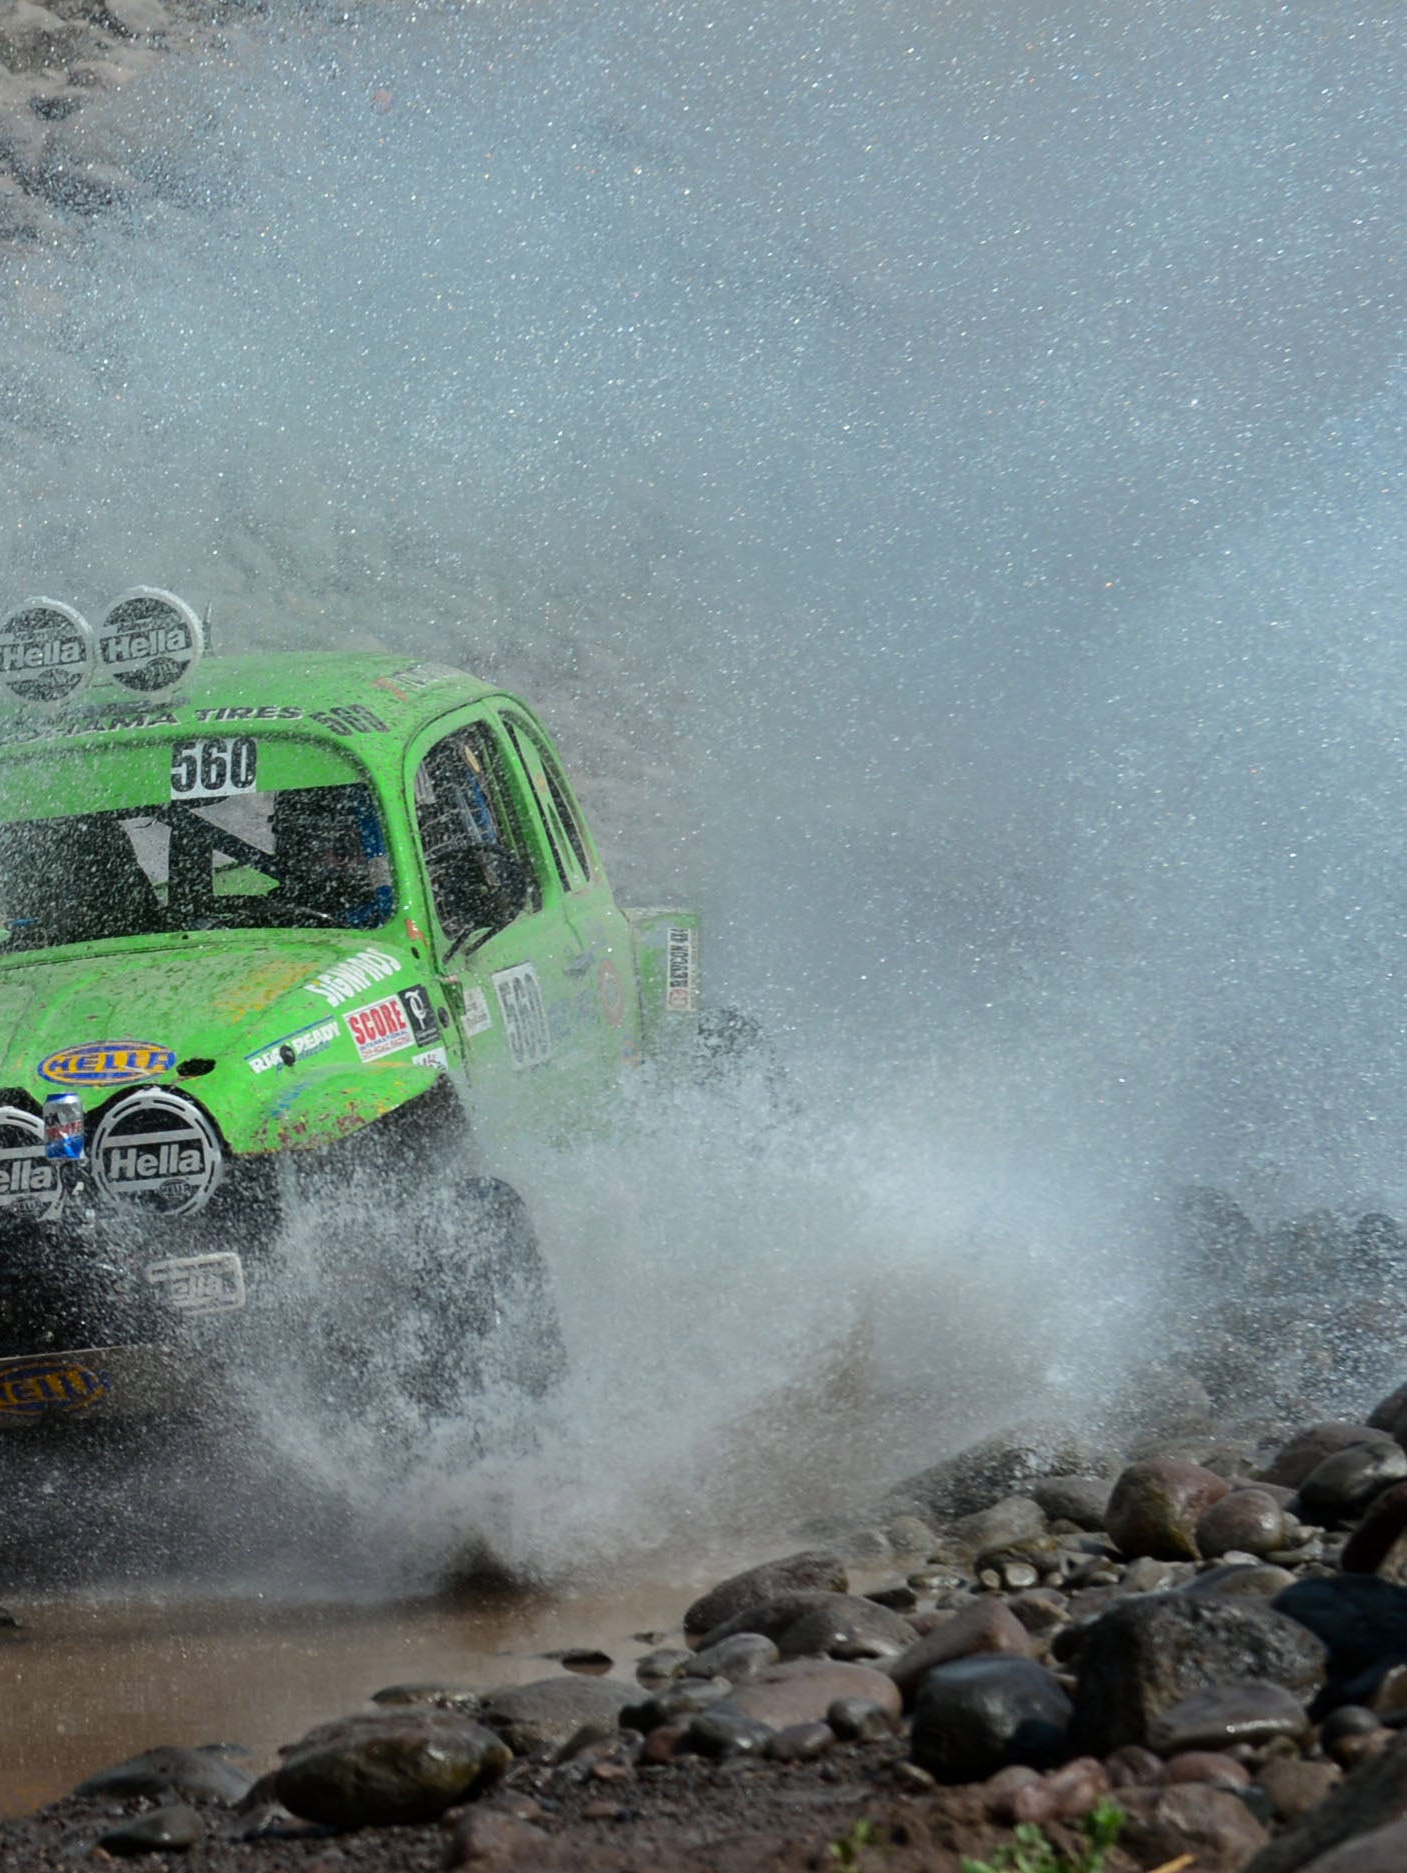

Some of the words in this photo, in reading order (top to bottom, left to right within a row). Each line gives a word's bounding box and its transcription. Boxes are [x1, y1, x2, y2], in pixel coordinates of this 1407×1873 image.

[1, 639, 82, 671] Hella
[107, 628, 187, 664] Hella
[195, 706, 304, 723] TIRES
[171, 737, 257, 793] 560
[292, 1021, 341, 1055] READY
[348, 1000, 408, 1046] SCORE
[46, 1049, 177, 1076] HELLA
[109, 1143, 204, 1180] Hella
